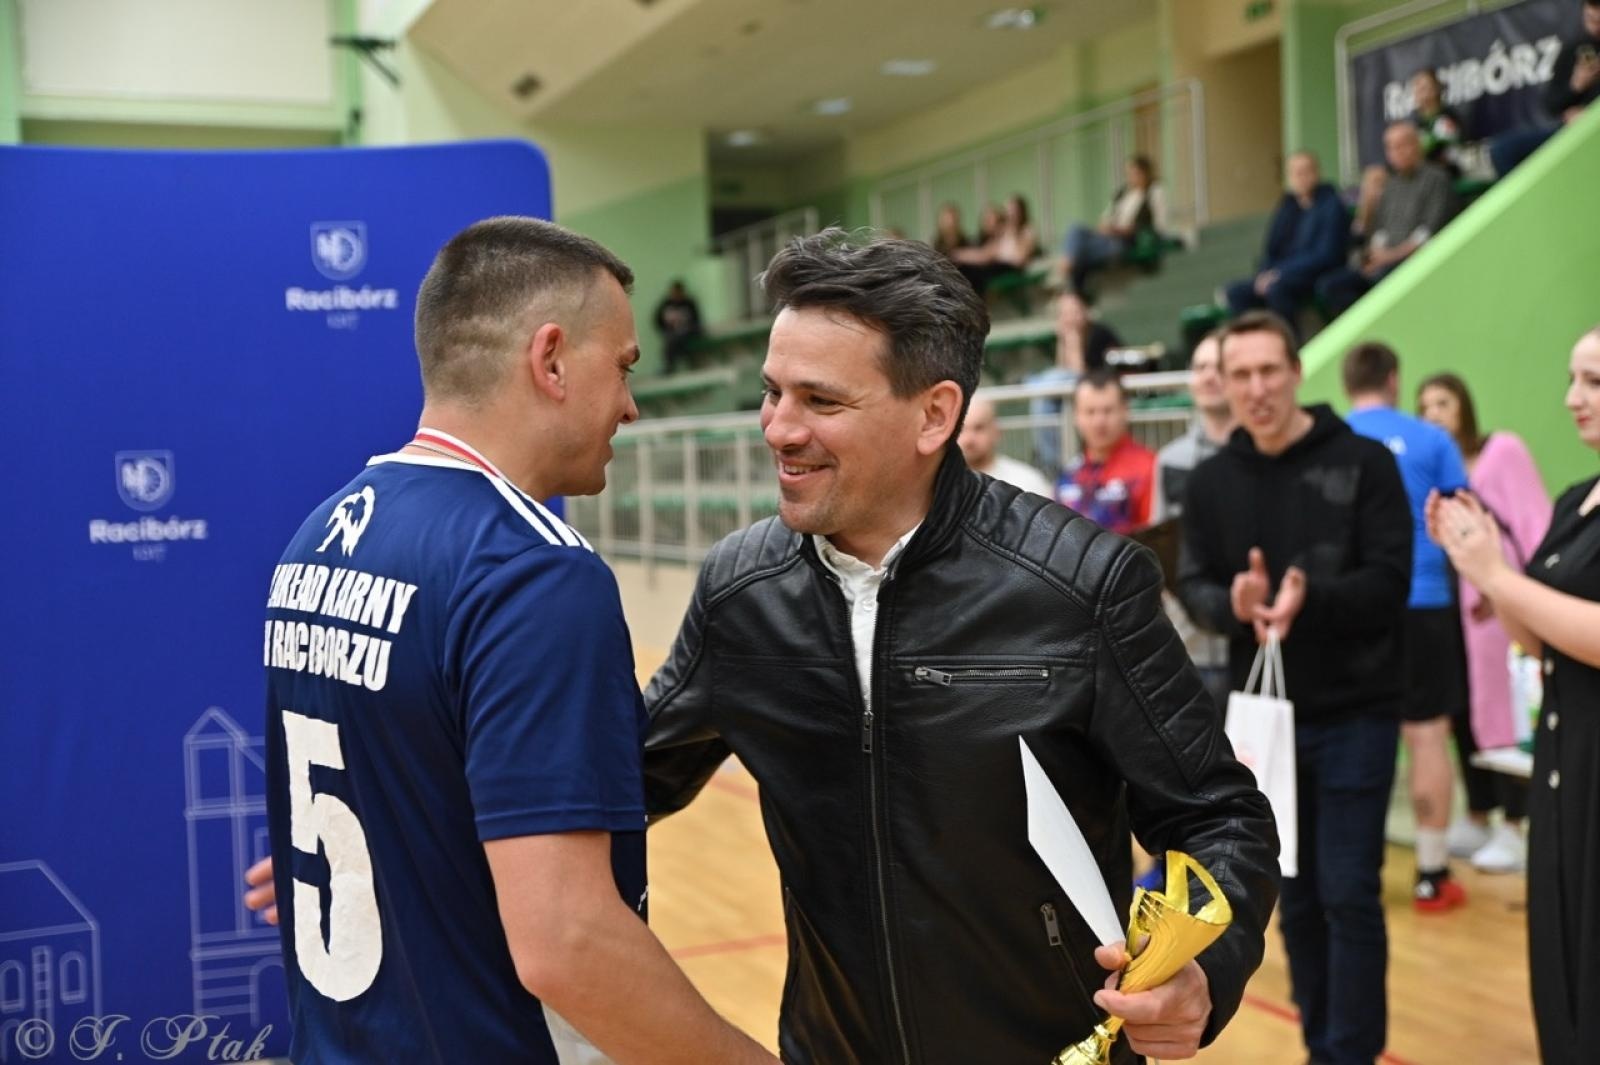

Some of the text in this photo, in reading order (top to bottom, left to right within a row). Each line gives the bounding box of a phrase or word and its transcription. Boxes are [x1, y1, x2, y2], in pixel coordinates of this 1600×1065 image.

[285, 284, 398, 311] Racibórz
[89, 515, 207, 544] Racibórz
[320, 567, 418, 634] KARNY
[282, 710, 383, 1002] 5
